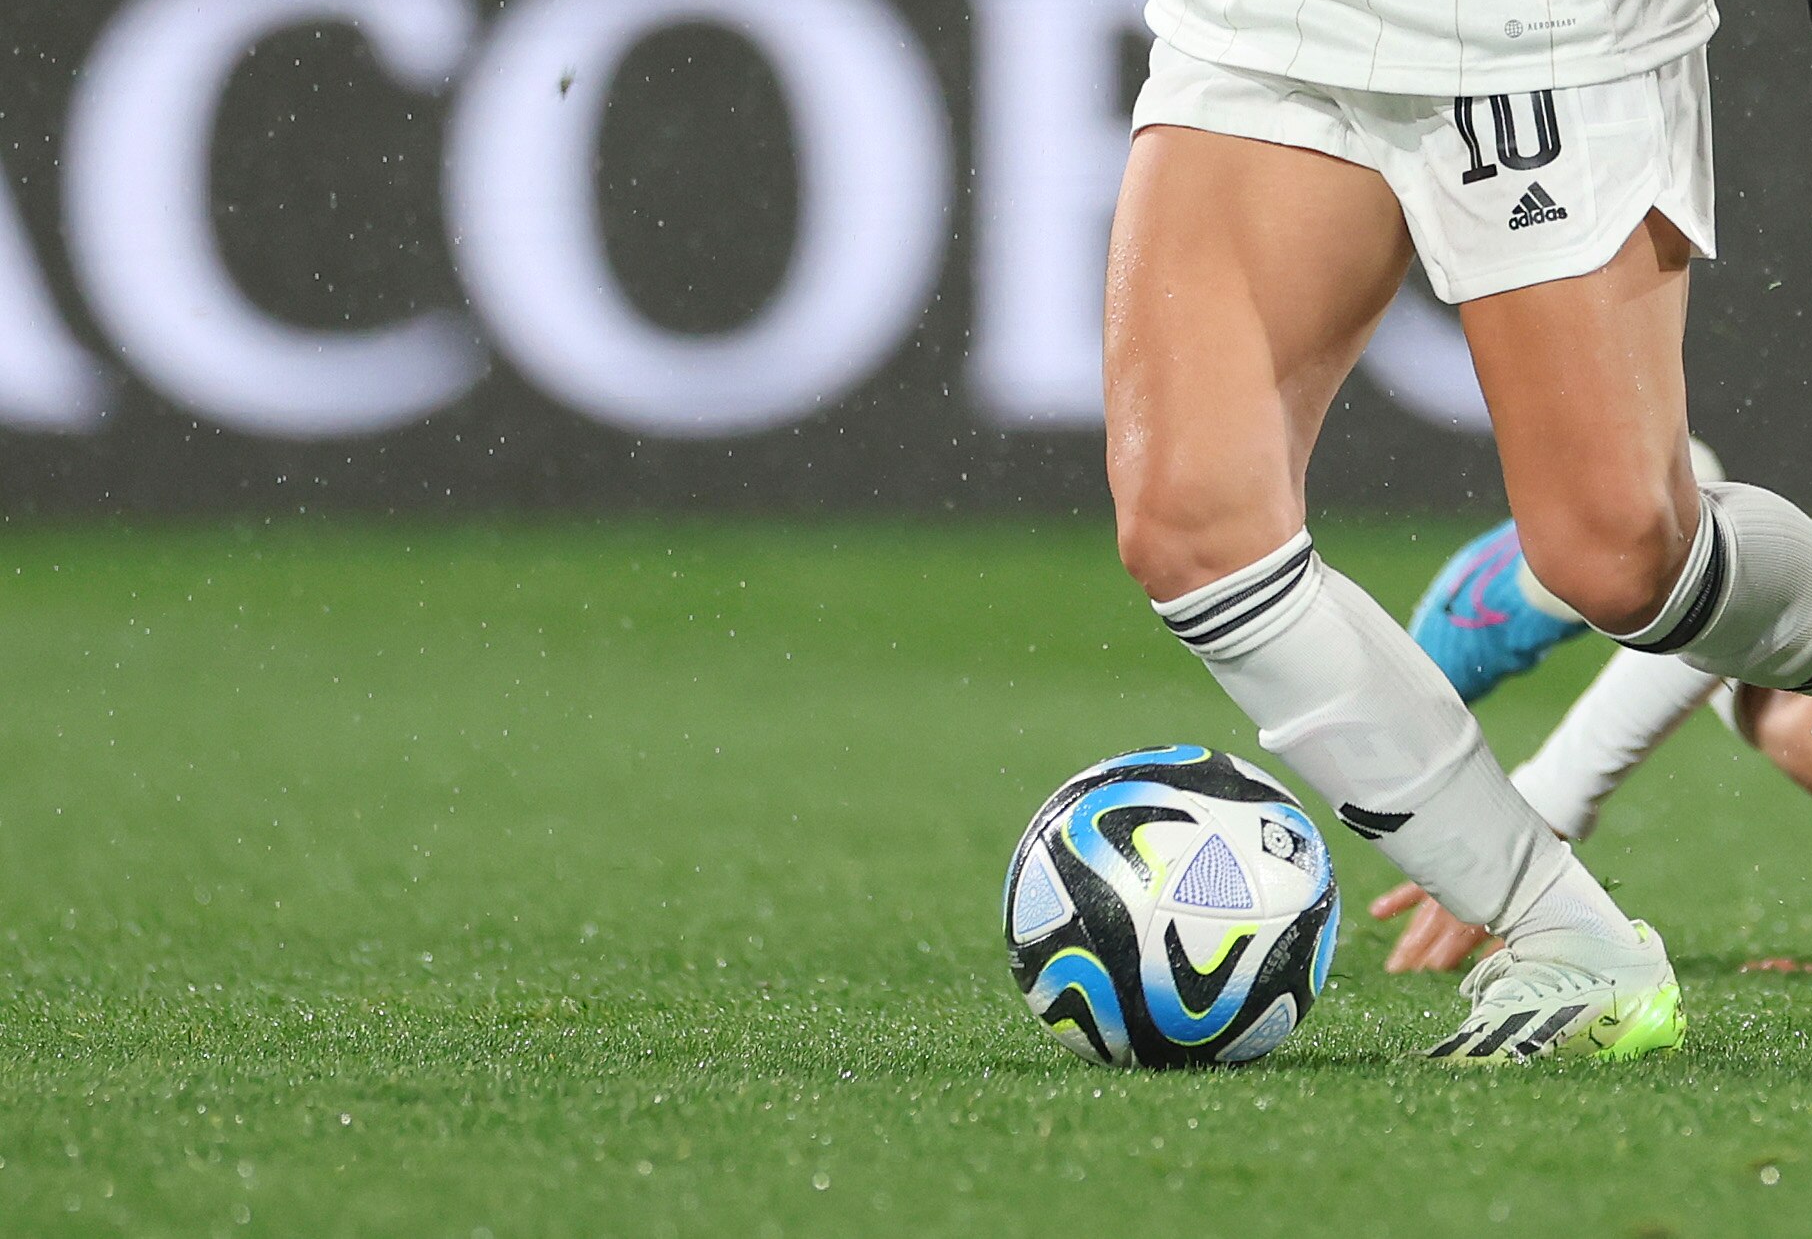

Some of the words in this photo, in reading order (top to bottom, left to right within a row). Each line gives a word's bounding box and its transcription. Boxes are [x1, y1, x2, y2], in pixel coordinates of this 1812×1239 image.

[1527, 17, 1577, 32] AEROREADY
[1454, 88, 1562, 185] 10
[1508, 205, 1568, 231] adidas
